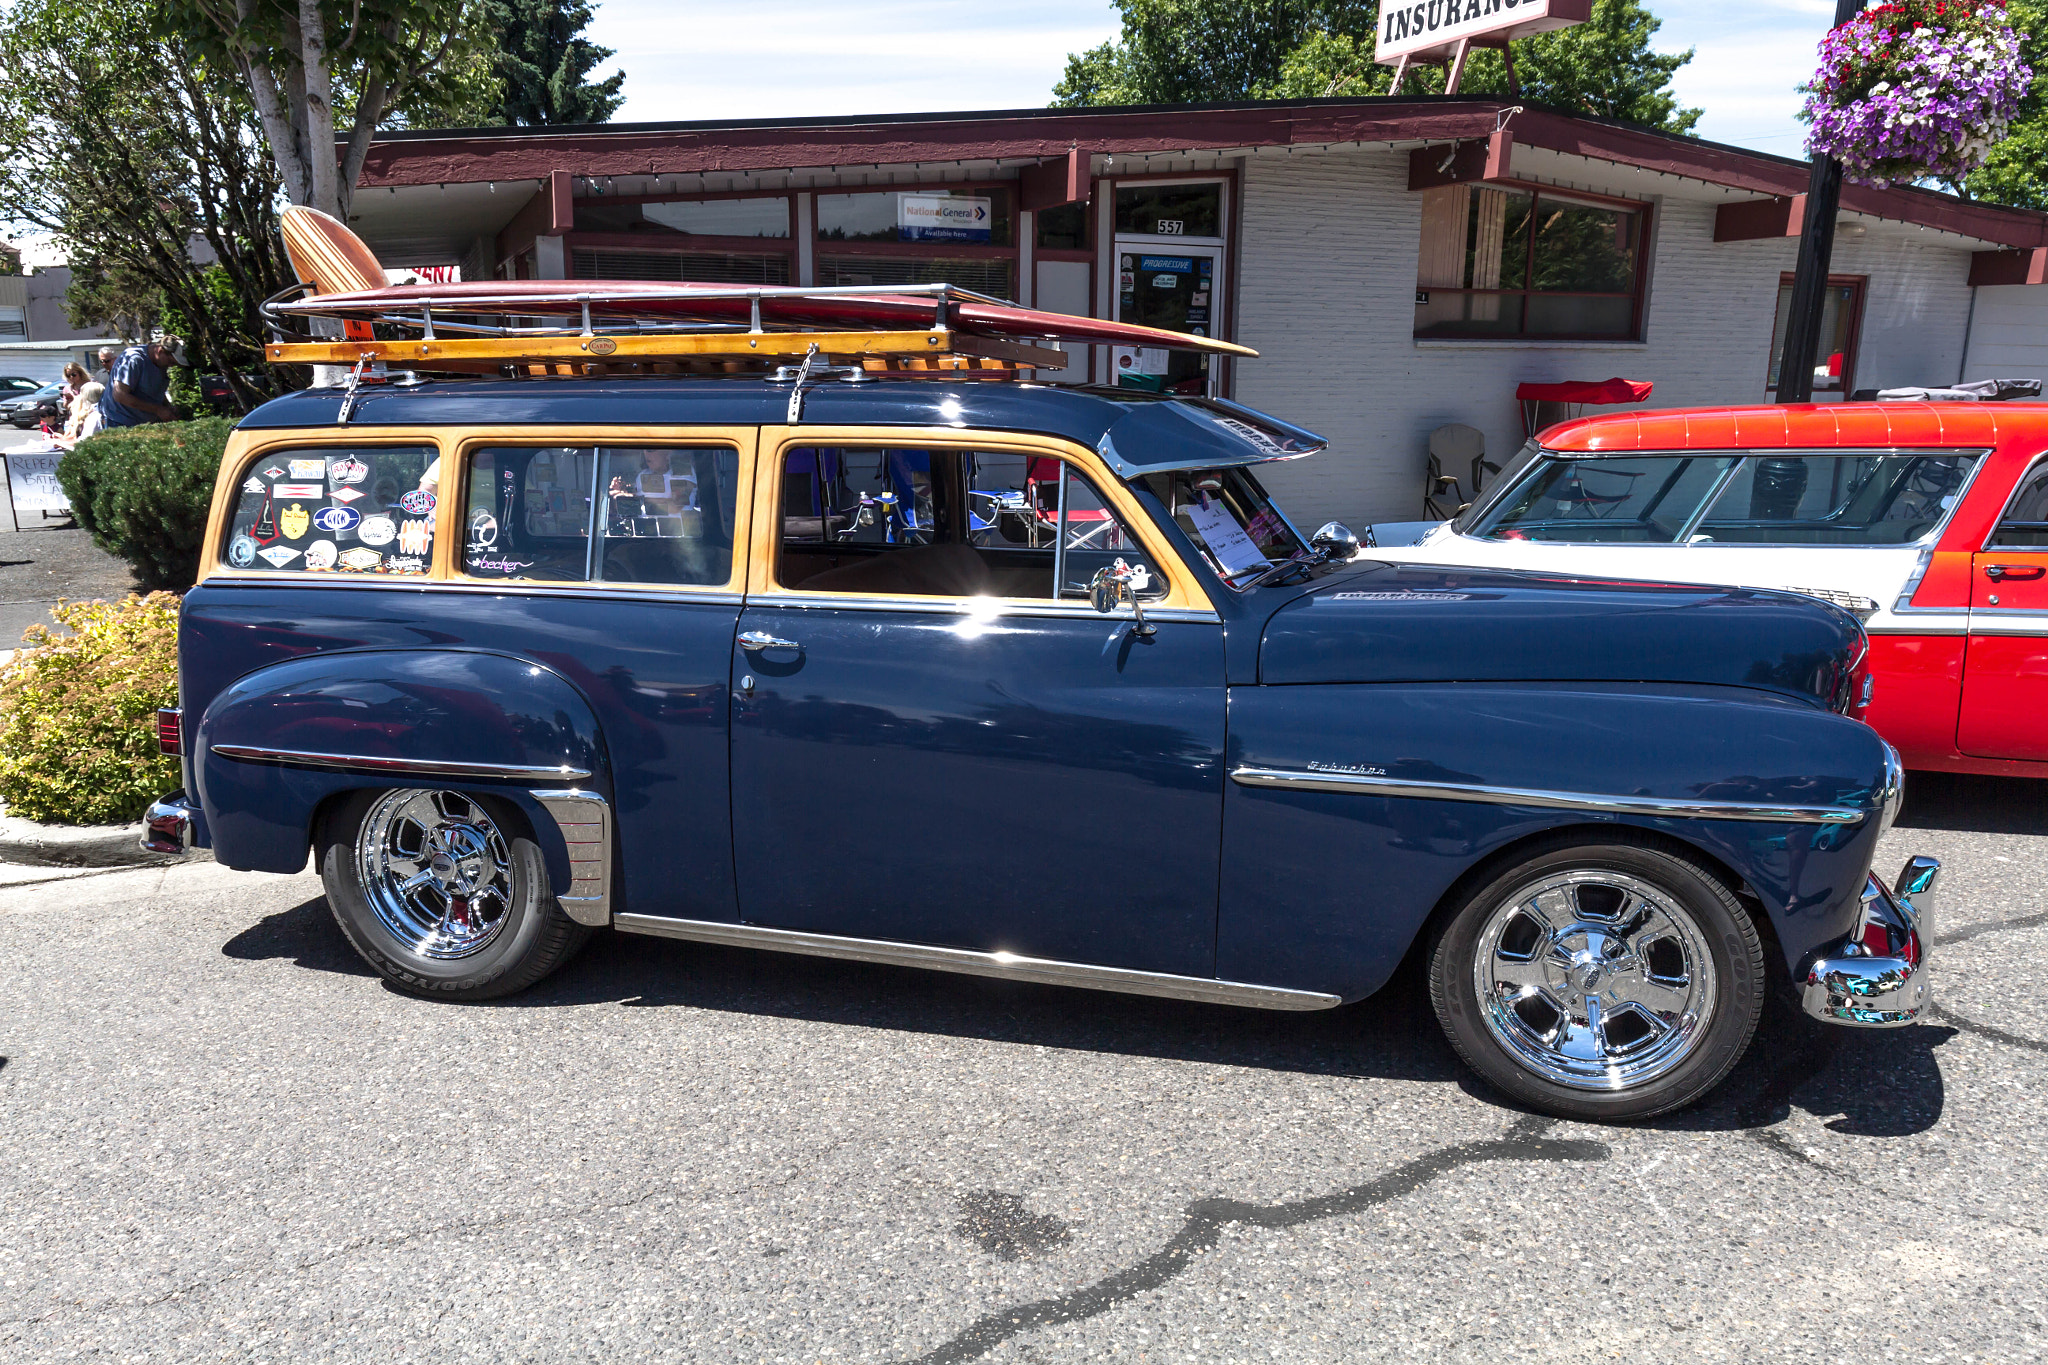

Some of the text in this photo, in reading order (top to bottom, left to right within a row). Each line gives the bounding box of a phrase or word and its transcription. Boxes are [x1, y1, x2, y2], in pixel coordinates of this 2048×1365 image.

[1384, 0, 1537, 44] INSURAN
[906, 207, 973, 218] National General
[1159, 221, 1182, 234] 557
[1143, 259, 1189, 270] PROGRESSIVE
[12, 456, 58, 470] REPEA
[42, 485, 63, 495] LA
[479, 554, 534, 573] becker
